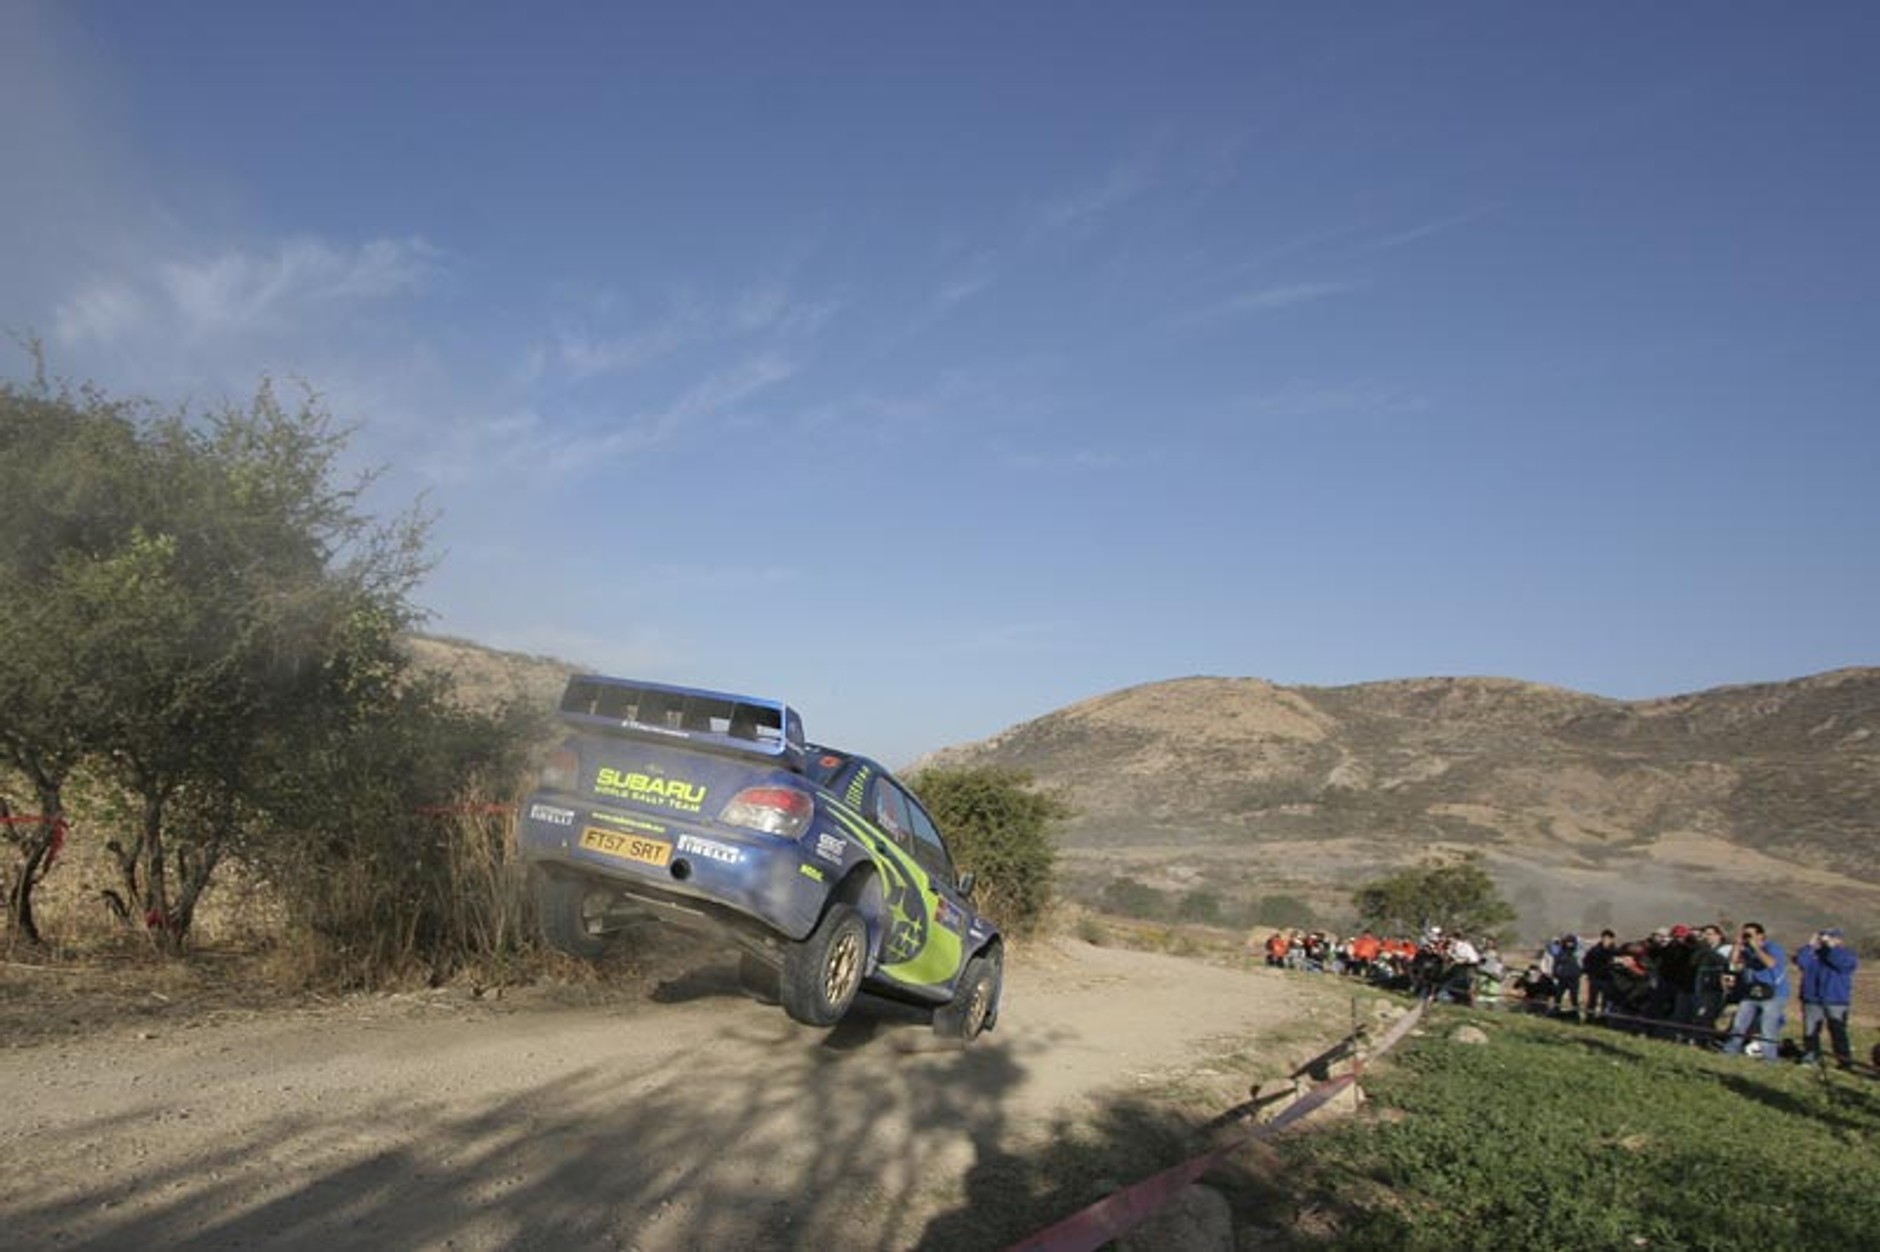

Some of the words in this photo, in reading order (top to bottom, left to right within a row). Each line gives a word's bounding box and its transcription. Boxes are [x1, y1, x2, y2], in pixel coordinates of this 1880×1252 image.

[597, 767, 706, 802] SUBARU
[669, 797, 701, 813] TEAM
[585, 829, 625, 851] FT57
[629, 839, 664, 861] SRT
